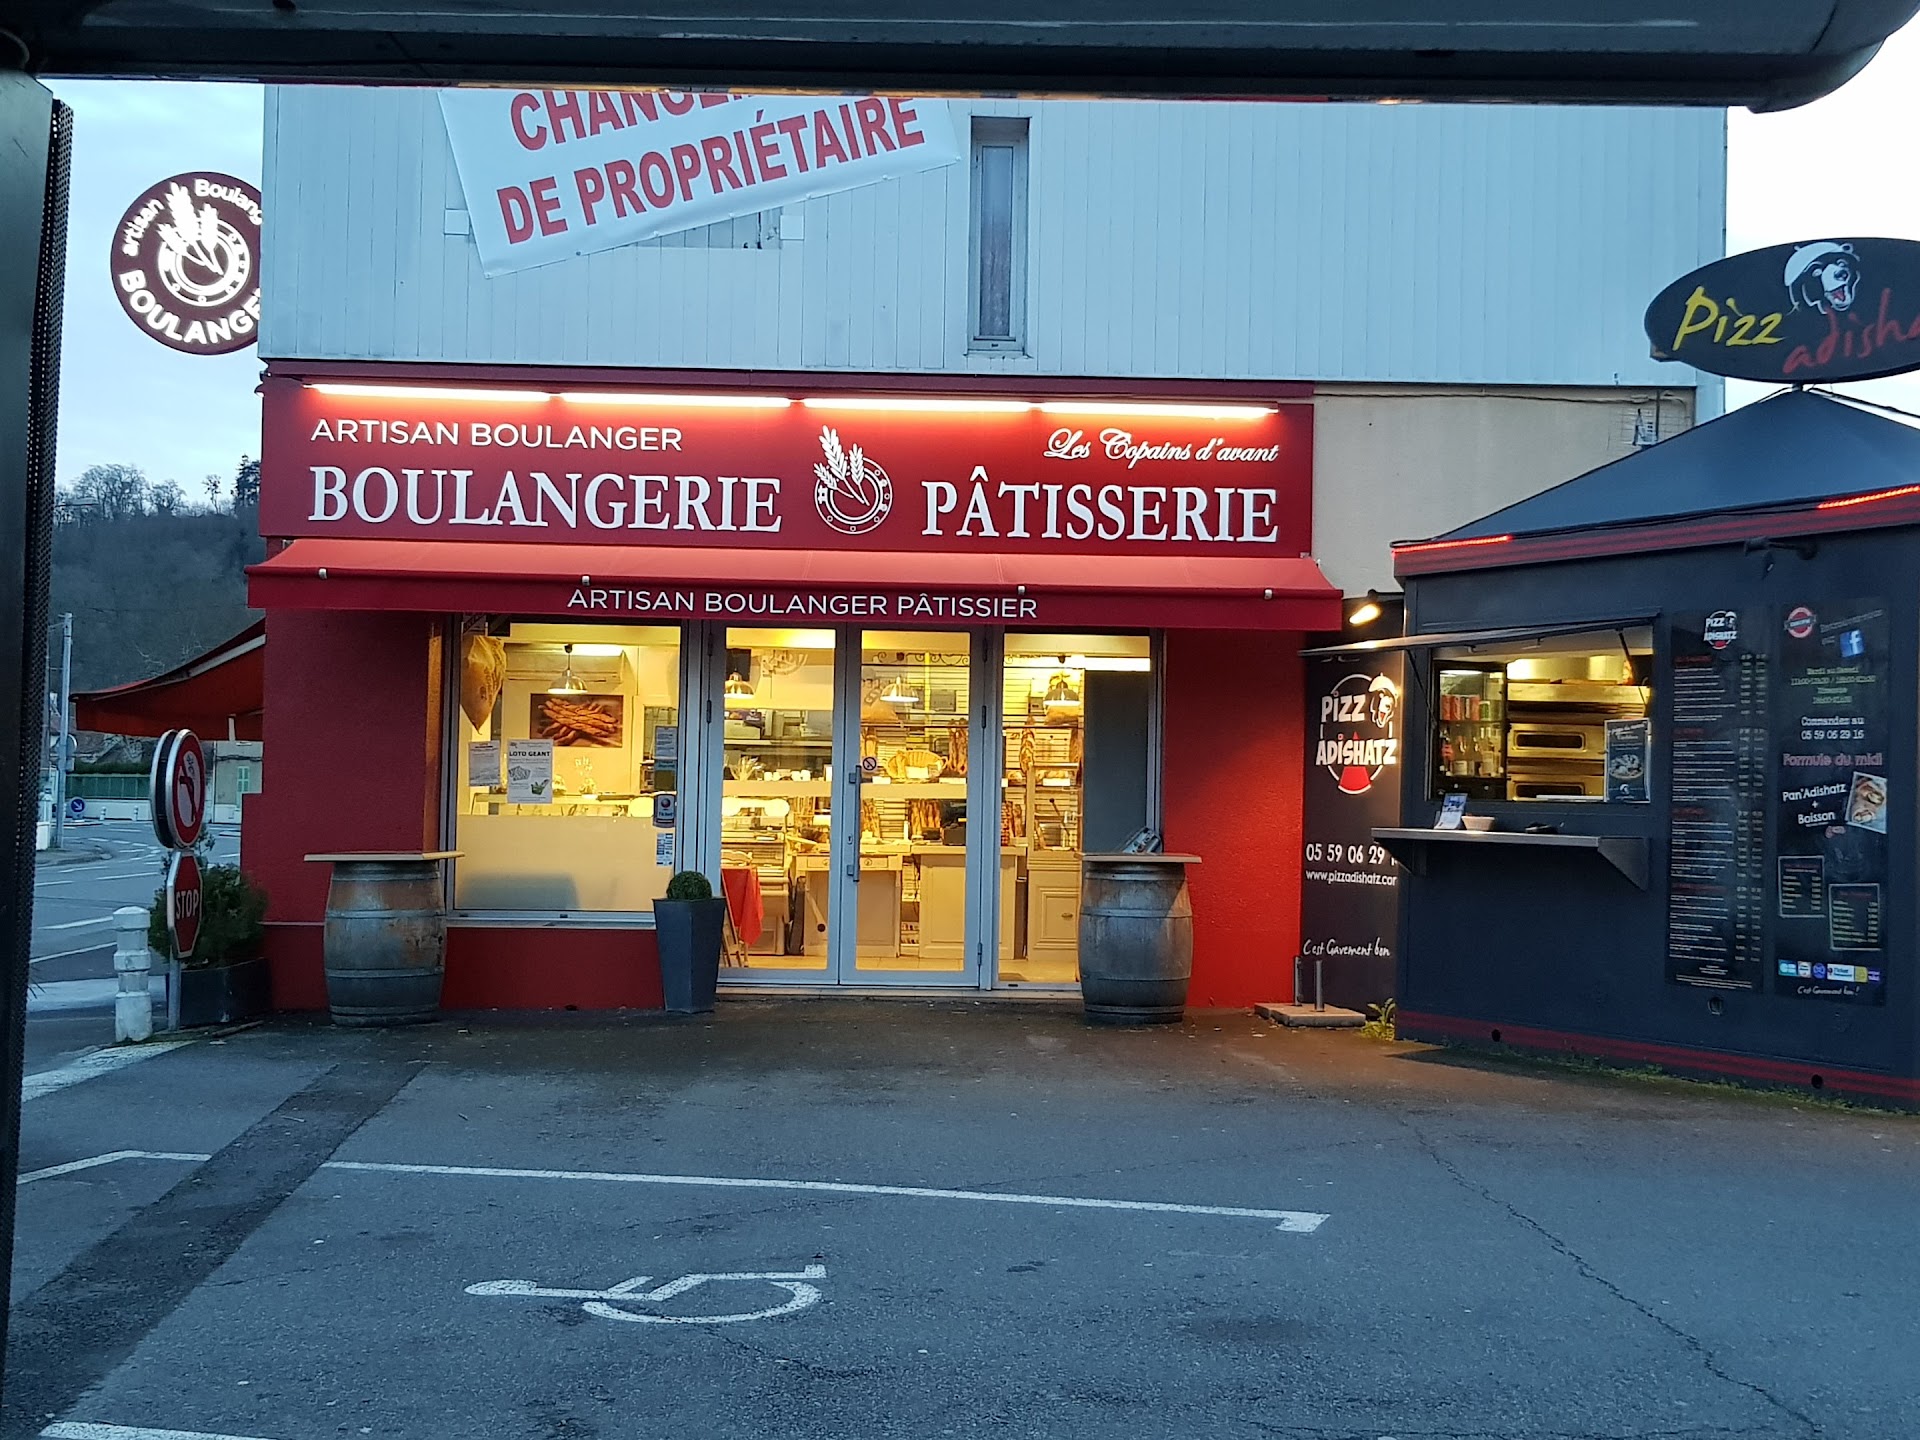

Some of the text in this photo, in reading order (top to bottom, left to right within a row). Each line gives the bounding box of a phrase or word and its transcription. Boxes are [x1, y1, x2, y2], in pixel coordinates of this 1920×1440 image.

[497, 97, 925, 244] DE PROPRIÉTAIRE
[119, 269, 261, 344] BOULANGE
[310, 418, 683, 451] ARTISAN BOULANGER
[1043, 427, 1280, 470] Les Copains d'avant
[307, 465, 1279, 543] BOULANGERIE PÂTISSERIE
[567, 588, 1038, 619] ARTISAN BOULANGER PÂTISSIER
[1814, 730, 1825, 740] 59
[1783, 752, 1883, 766] Formule du midi
[1798, 811, 1836, 824] Boisson
[1306, 843, 1323, 862] 05
[1326, 843, 1343, 863] 59
[1347, 844, 1364, 864] 06
[1368, 845, 1386, 865] 29
[175, 889, 199, 920] STOP
[1325, 938, 1373, 956] Gavement
[1374, 936, 1391, 956] bon
